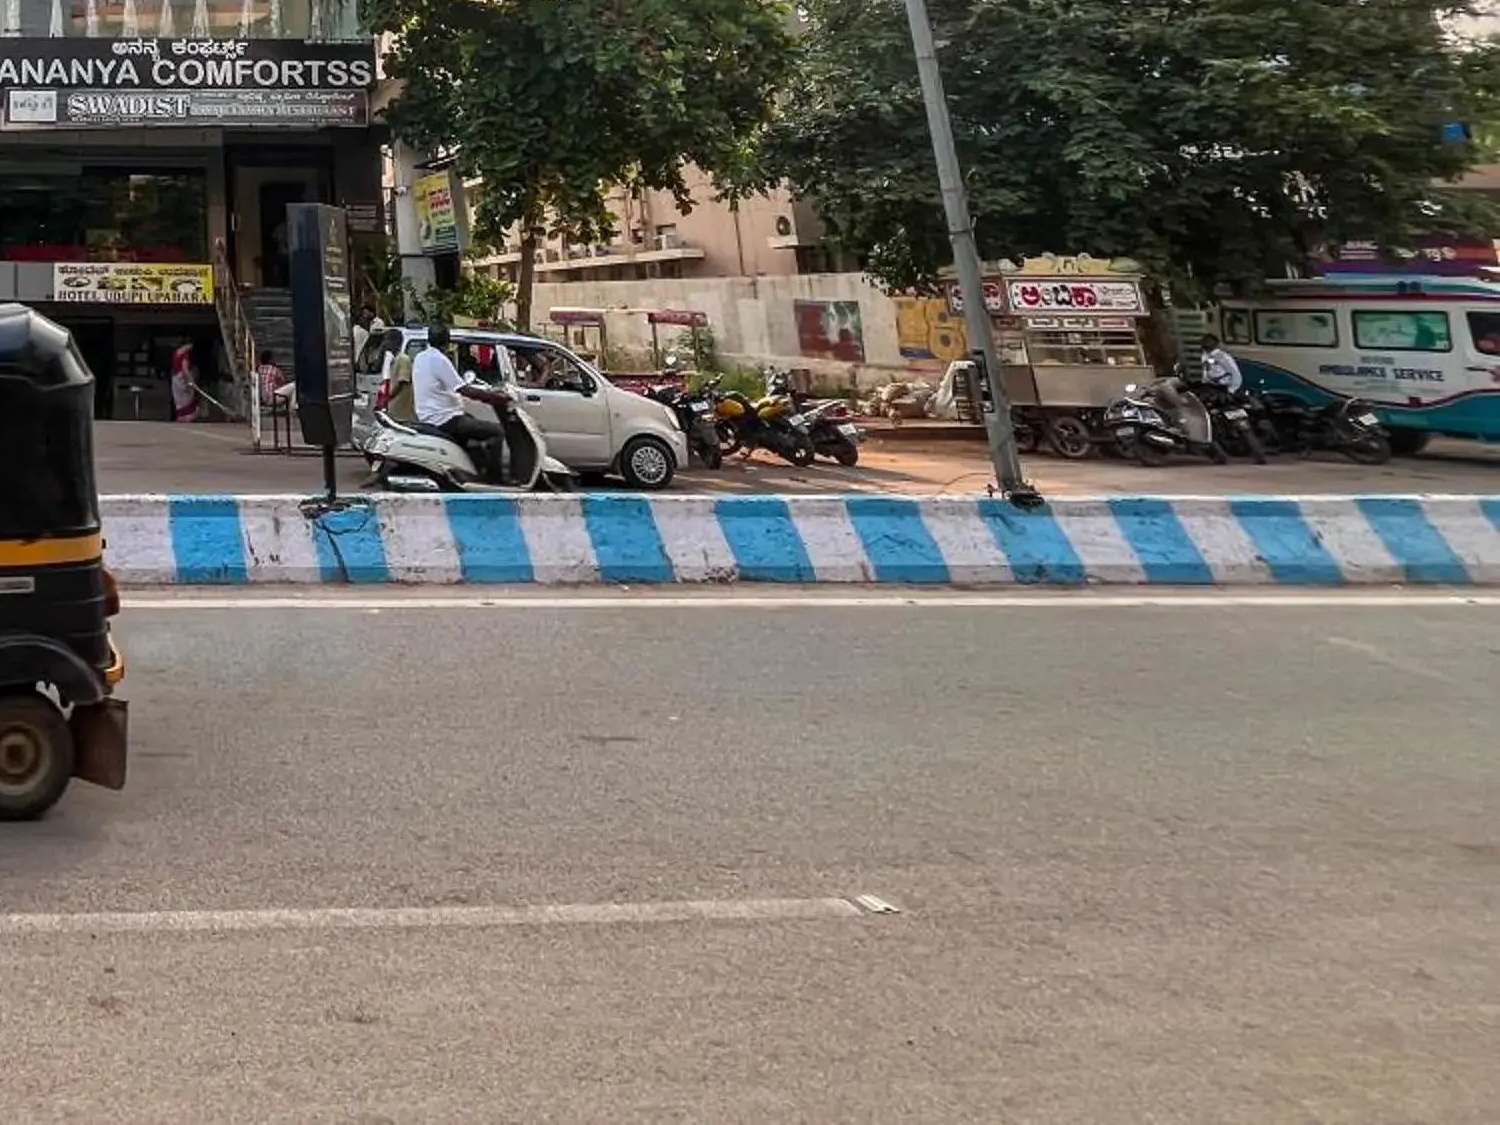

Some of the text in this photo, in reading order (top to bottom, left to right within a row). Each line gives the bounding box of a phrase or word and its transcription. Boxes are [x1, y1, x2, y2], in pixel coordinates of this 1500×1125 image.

[111, 40, 160, 61] ಅನನ್ಯ
[151, 59, 372, 86] COMFORTSS
[67, 92, 191, 118] SWADIST
[58, 291, 98, 302] HOTEL
[1393, 368, 1444, 382] SERVICE
